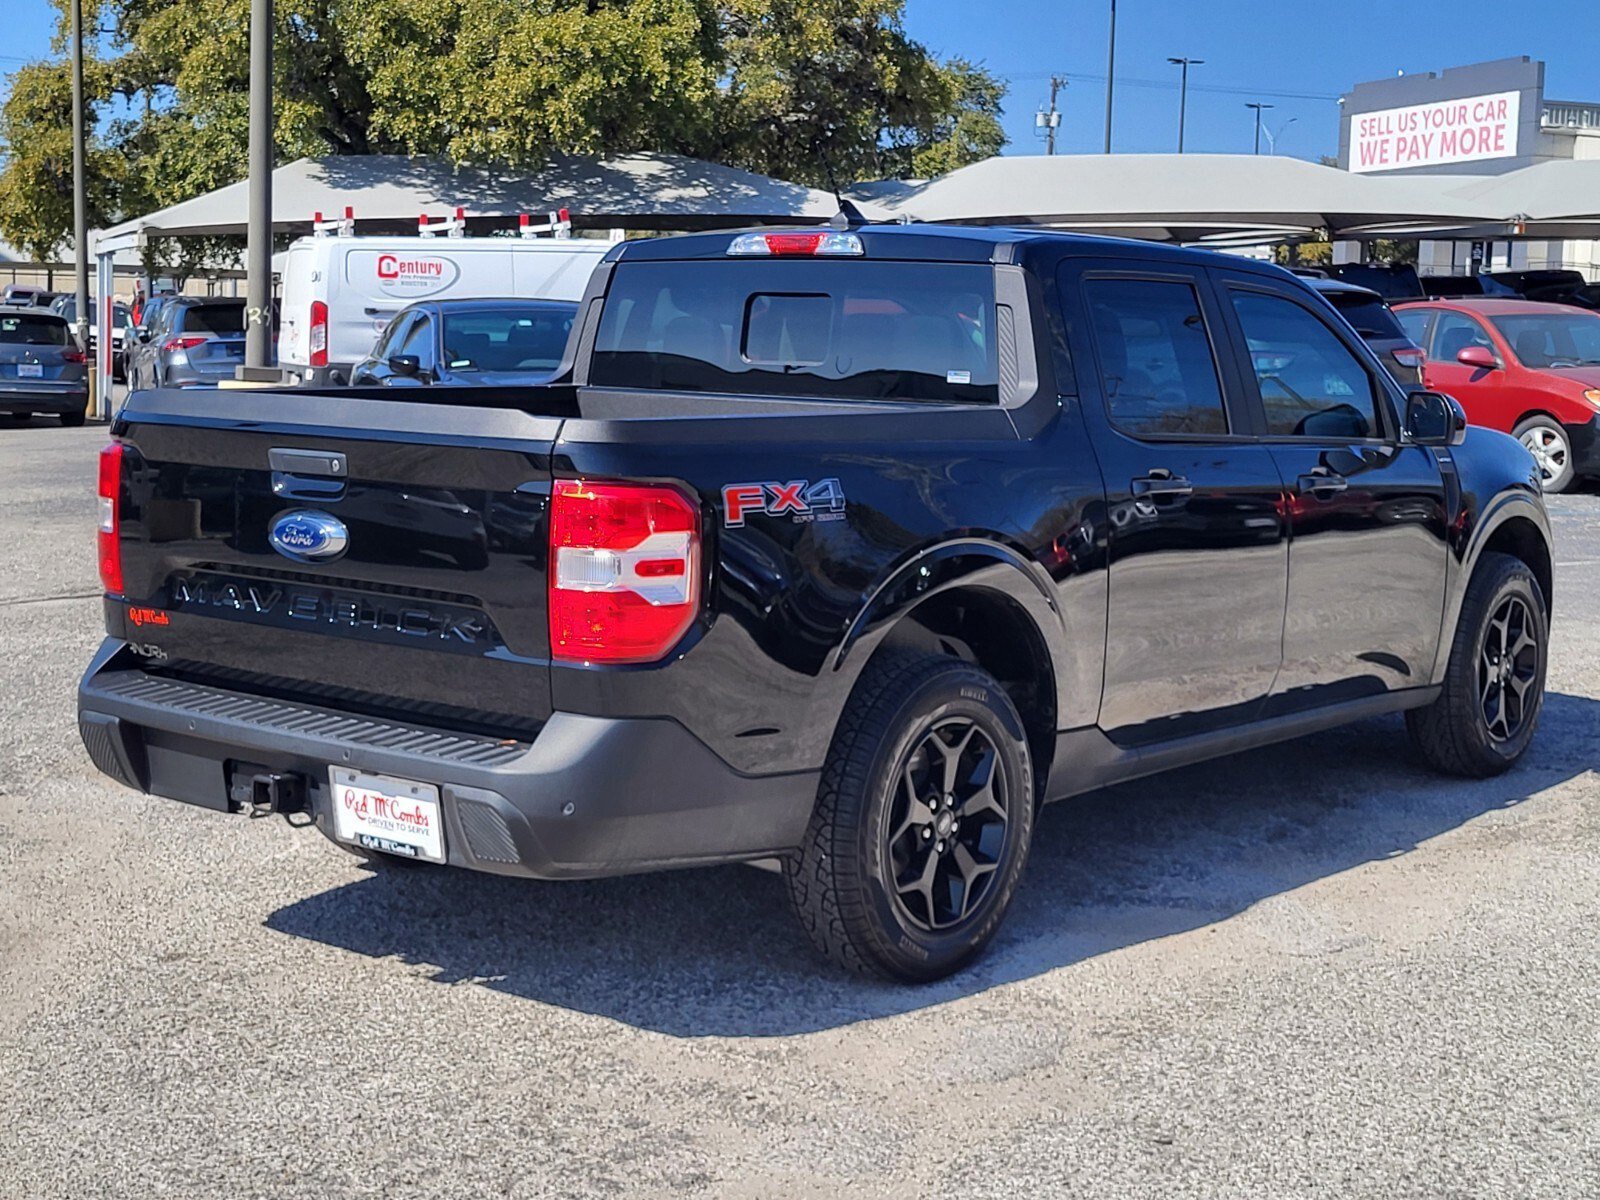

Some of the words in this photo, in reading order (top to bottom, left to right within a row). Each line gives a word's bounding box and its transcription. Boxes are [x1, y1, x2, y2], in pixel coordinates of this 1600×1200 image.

[1360, 114, 1393, 137] SELL
[1398, 111, 1417, 132] US
[1423, 105, 1468, 130] YOUR
[1473, 99, 1507, 123] CAR
[1360, 138, 1389, 166] WE
[1396, 132, 1435, 162] PAY
[1439, 124, 1506, 157] MORE
[377, 255, 442, 279] Century
[721, 478, 847, 528] FX4
[282, 523, 314, 546] Ford
[175, 577, 482, 643] MAVERICK
[344, 788, 369, 821] Red
[368, 817, 394, 831] DRIVEN
[396, 822, 407, 831] TO
[408, 825, 431, 837] SERVE
